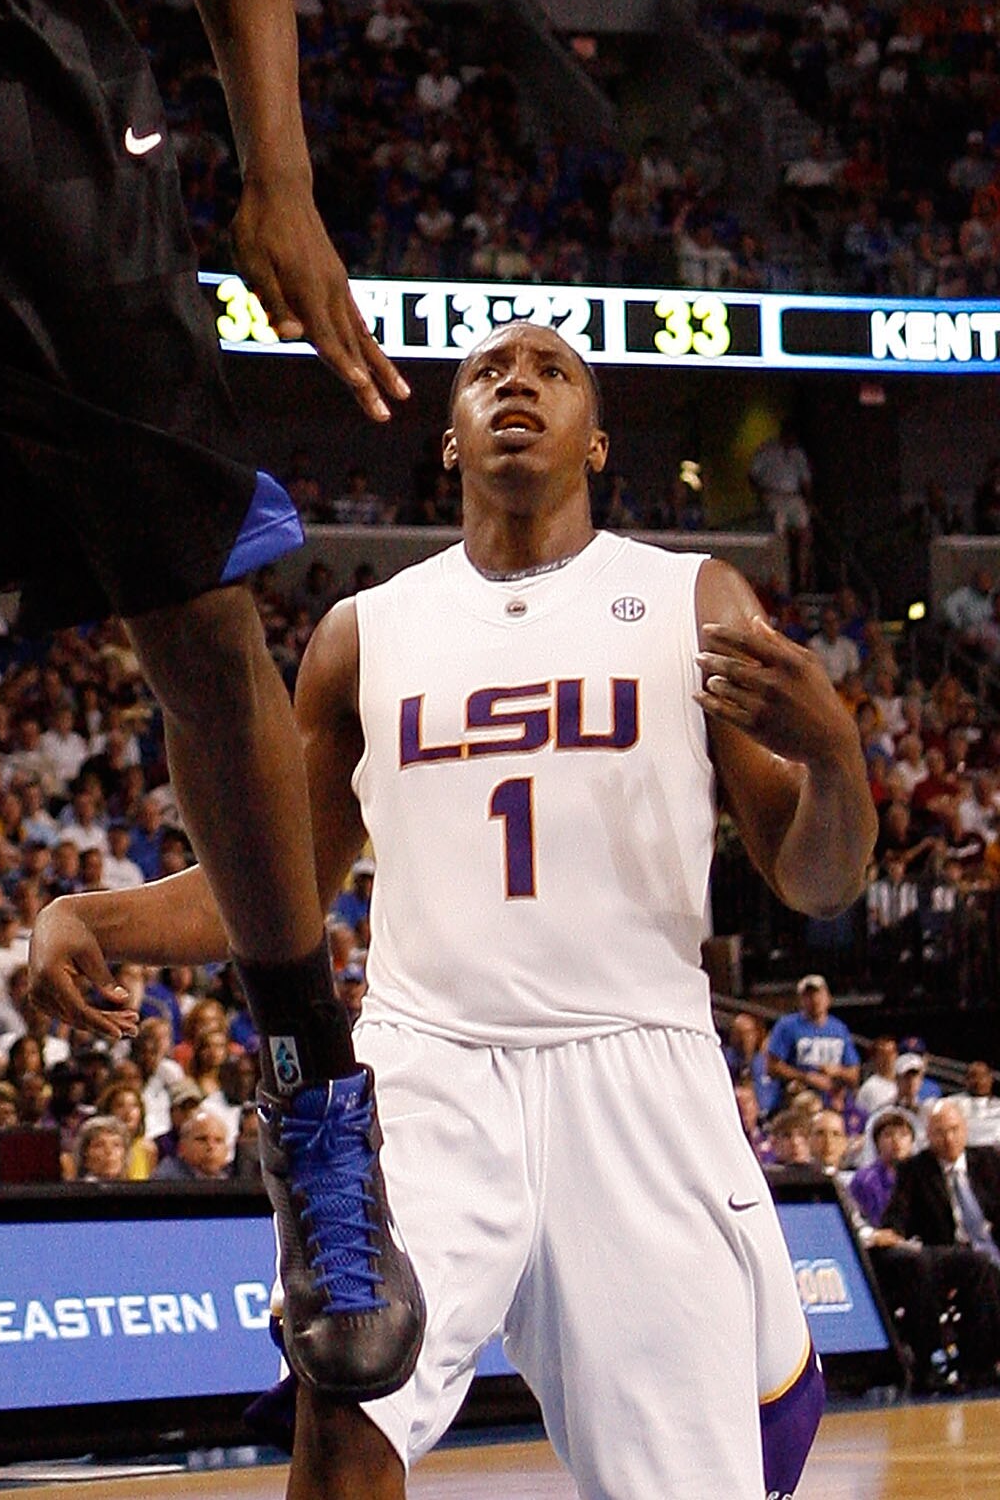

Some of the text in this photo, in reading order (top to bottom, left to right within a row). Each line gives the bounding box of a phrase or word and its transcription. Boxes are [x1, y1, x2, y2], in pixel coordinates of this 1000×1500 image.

[654, 295, 731, 357] 33
[870, 310, 1000, 362] KENT
[611, 597, 646, 622] SEC
[399, 676, 640, 770] LSU
[488, 775, 538, 901] 1
